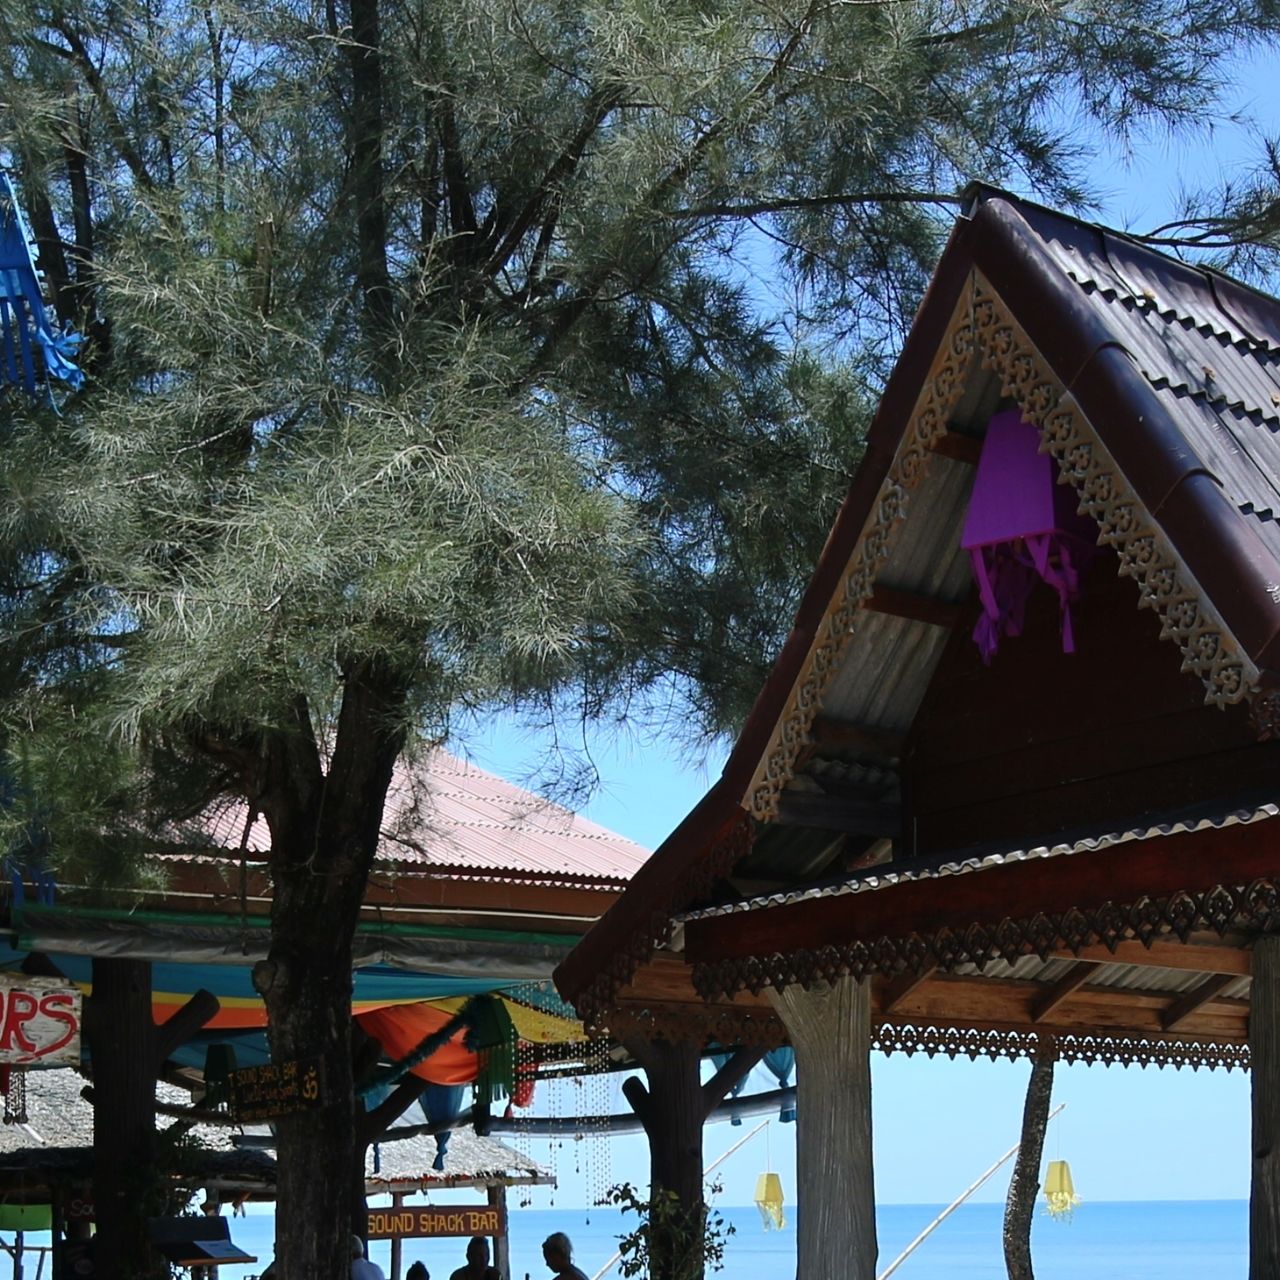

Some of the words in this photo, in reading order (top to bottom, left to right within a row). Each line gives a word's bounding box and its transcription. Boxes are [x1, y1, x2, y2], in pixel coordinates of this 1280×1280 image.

[367, 1213, 414, 1234] SOUND
[420, 1213, 465, 1233] SHACK
[466, 1211, 498, 1231] BAR
